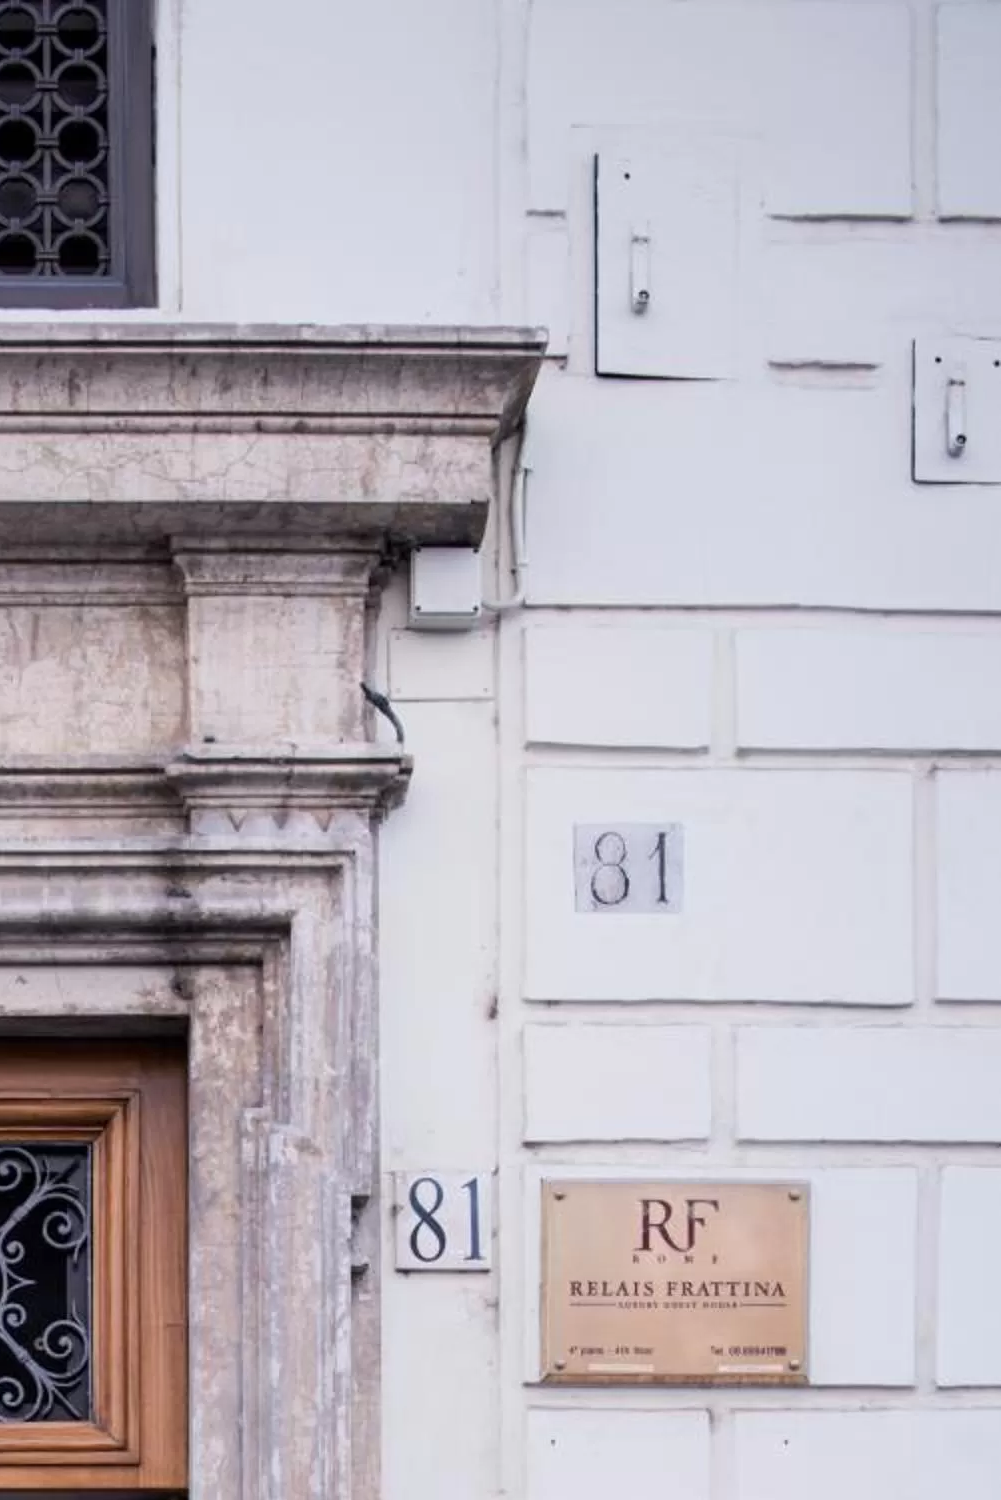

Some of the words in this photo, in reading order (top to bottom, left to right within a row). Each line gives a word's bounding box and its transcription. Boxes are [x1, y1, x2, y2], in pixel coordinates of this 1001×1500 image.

[589, 831, 670, 907] 81
[407, 1178, 485, 1263] 81
[633, 1198, 719, 1253] RF
[569, 1280, 655, 1297] RELAIS
[667, 1280, 786, 1298] FRATTINA
